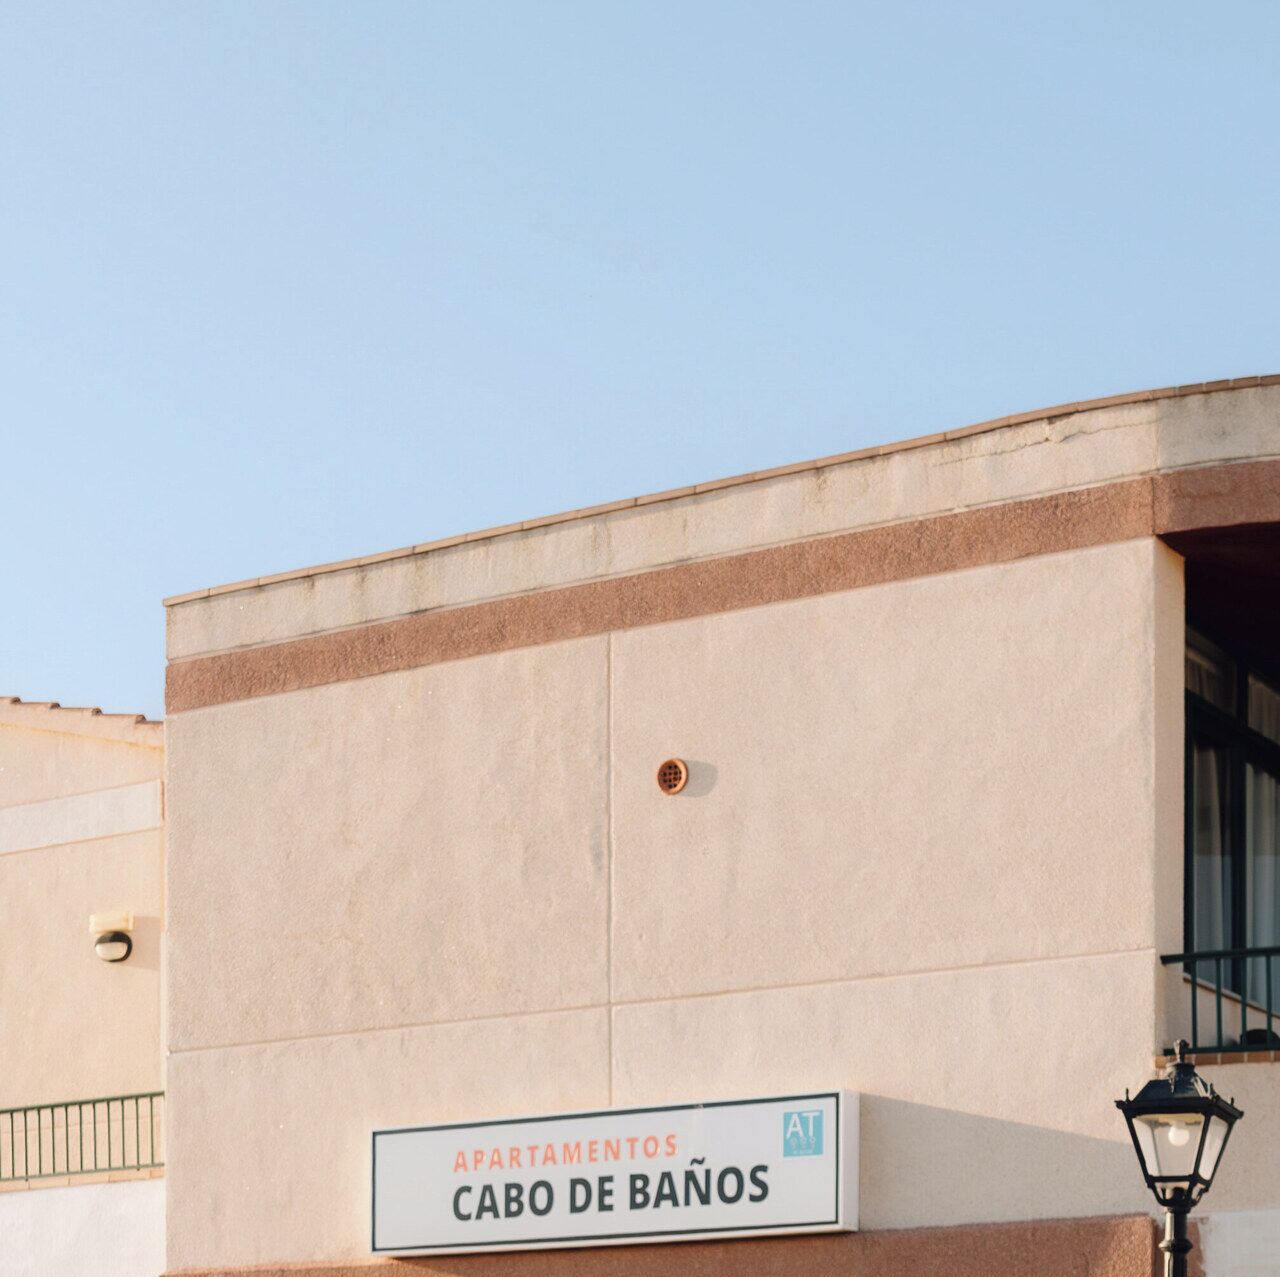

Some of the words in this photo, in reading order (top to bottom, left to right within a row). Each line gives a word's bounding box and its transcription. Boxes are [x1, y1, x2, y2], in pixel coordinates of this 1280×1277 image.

[786, 1111, 820, 1139] AT
[453, 1134, 678, 1173] APARTAMENTOS
[452, 1179, 555, 1222] CABO
[569, 1175, 614, 1214] DE
[629, 1157, 769, 1210] BAÑOS
